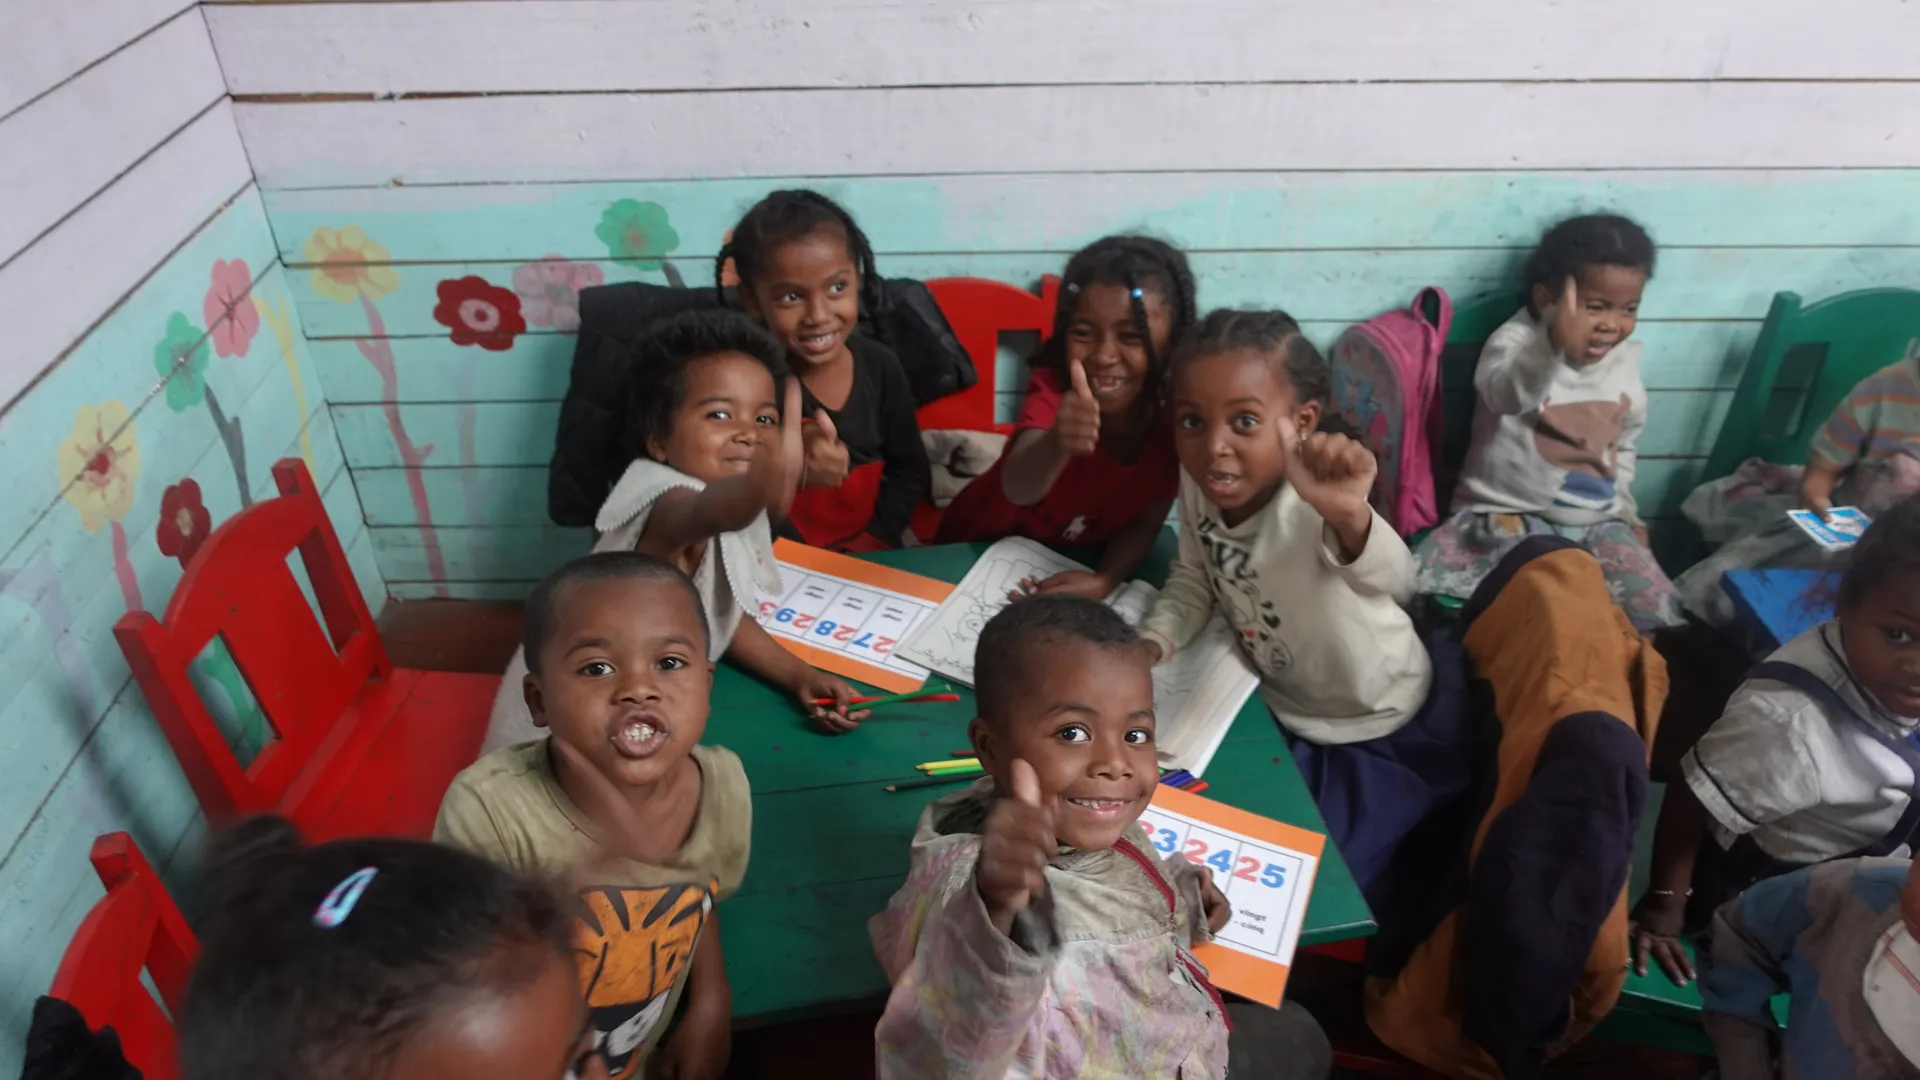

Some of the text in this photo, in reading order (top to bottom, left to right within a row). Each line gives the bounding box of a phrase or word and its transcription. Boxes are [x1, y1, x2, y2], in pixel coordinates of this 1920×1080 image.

[755, 599, 897, 654] 27 28 29 3
[1185, 838, 1232, 873] 24
[1233, 855, 1287, 889] 25
[1239, 908, 1267, 922] vingt
